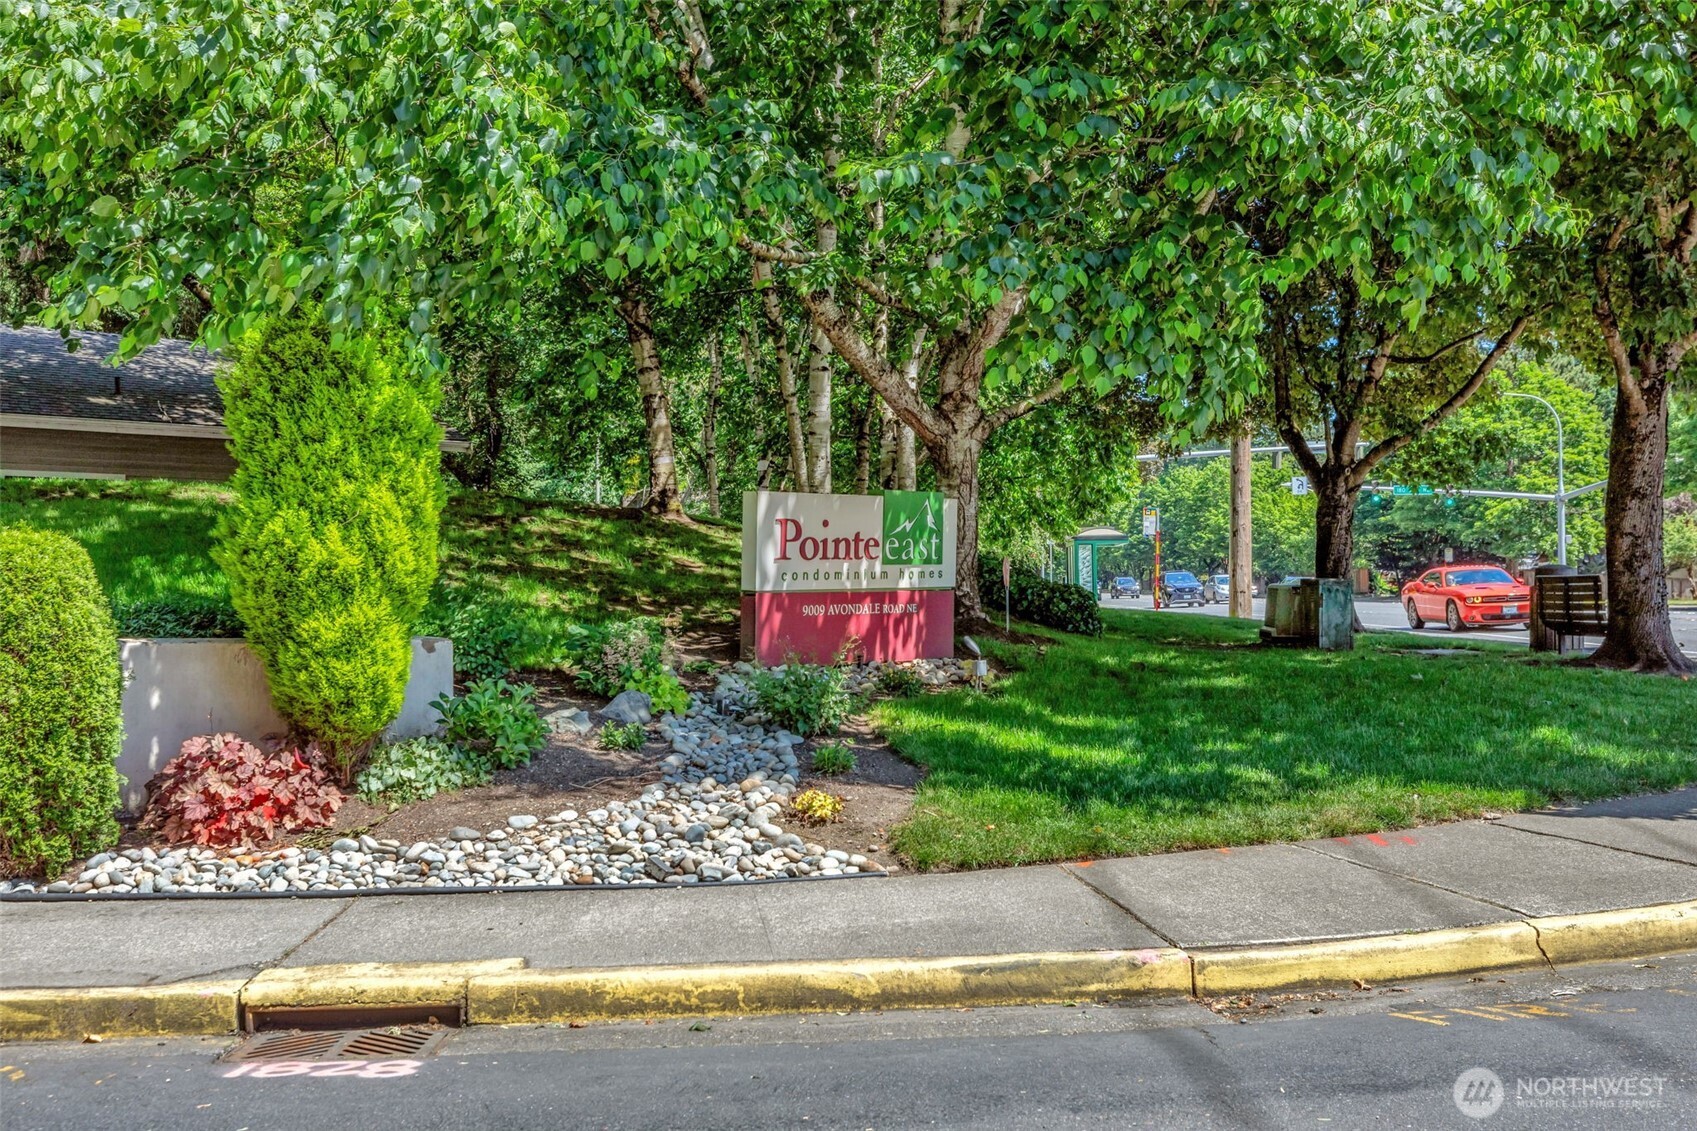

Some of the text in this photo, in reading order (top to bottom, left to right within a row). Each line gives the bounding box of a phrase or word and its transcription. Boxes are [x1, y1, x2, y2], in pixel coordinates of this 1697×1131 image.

[774, 518, 939, 562] Pointe east
[781, 567, 944, 582] condominium homes
[802, 603, 918, 616] 9009 AVONDALE ROAD NE
